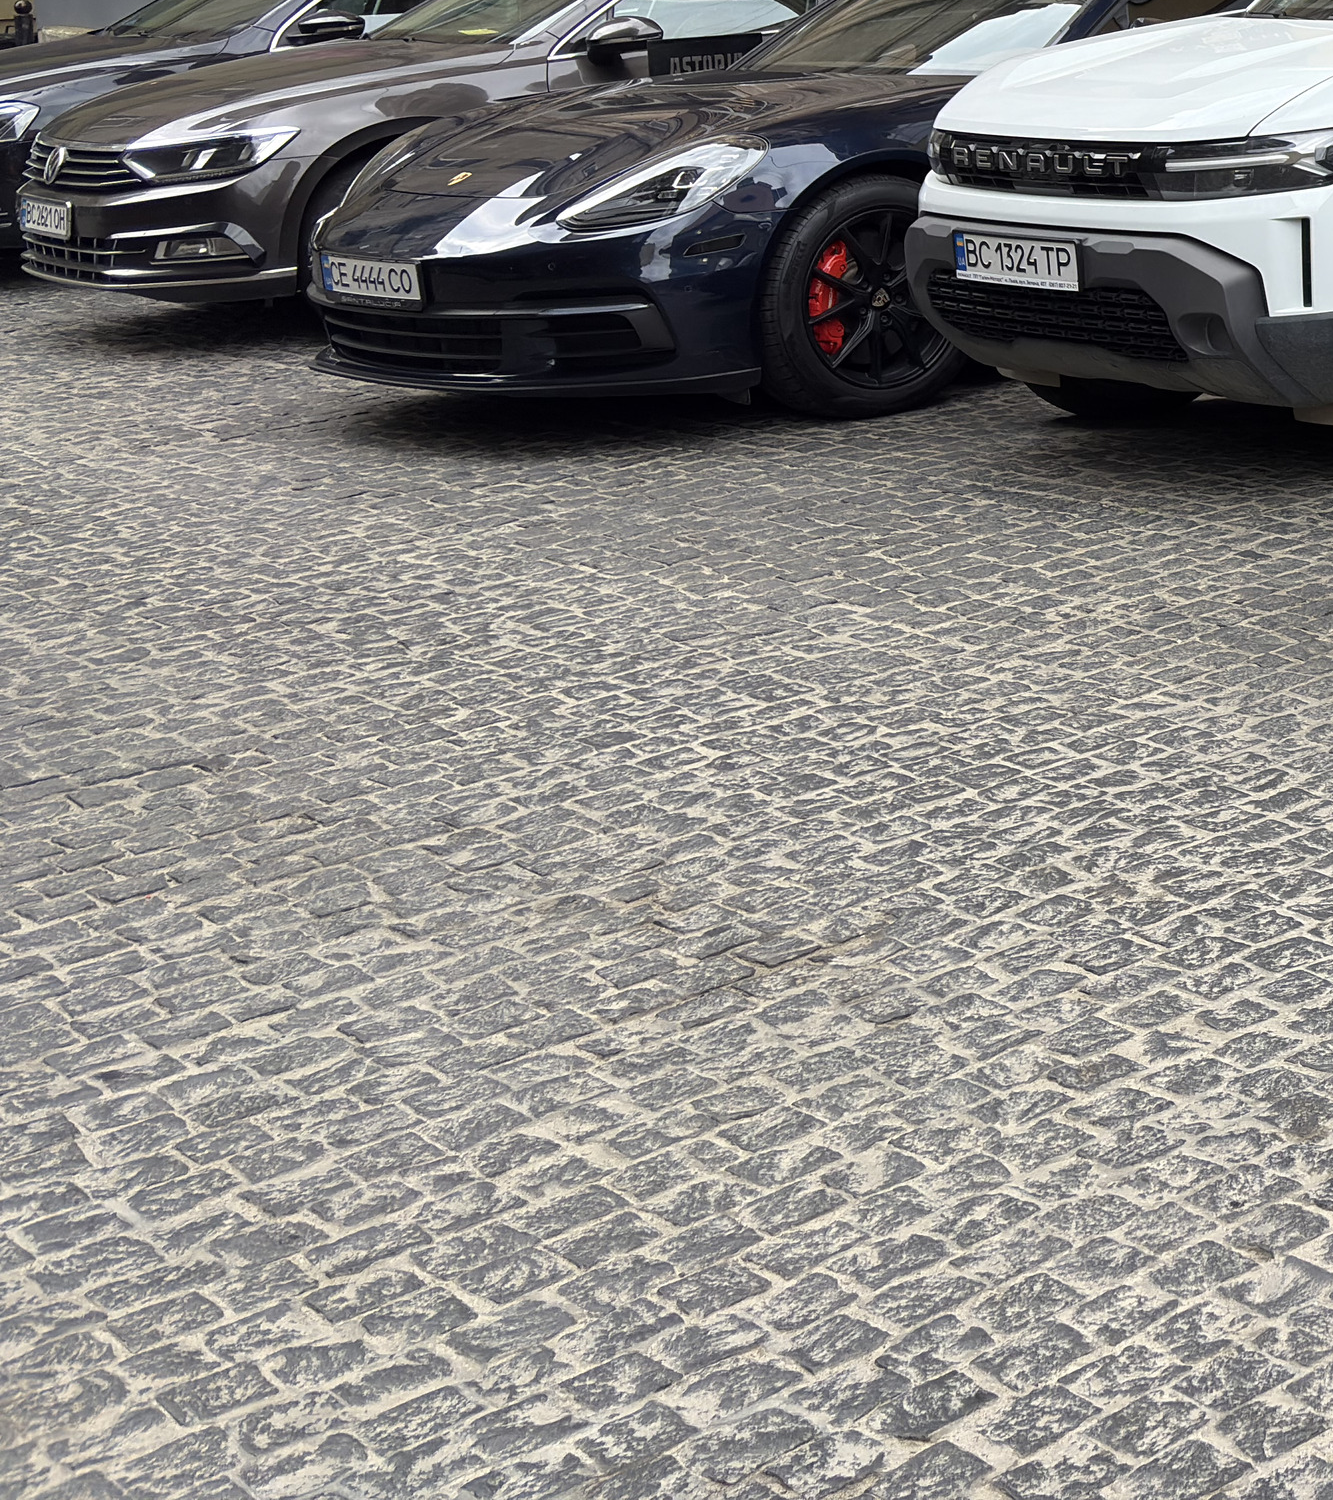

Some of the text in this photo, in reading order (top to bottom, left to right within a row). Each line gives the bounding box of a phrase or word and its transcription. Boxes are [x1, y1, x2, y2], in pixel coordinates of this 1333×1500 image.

[953, 146, 1129, 176] RENAULT
[965, 238, 992, 269] BC
[994, 242, 1038, 274] 1324
[1040, 246, 1071, 276] TP
[330, 261, 412, 294] CE 4444 CO
